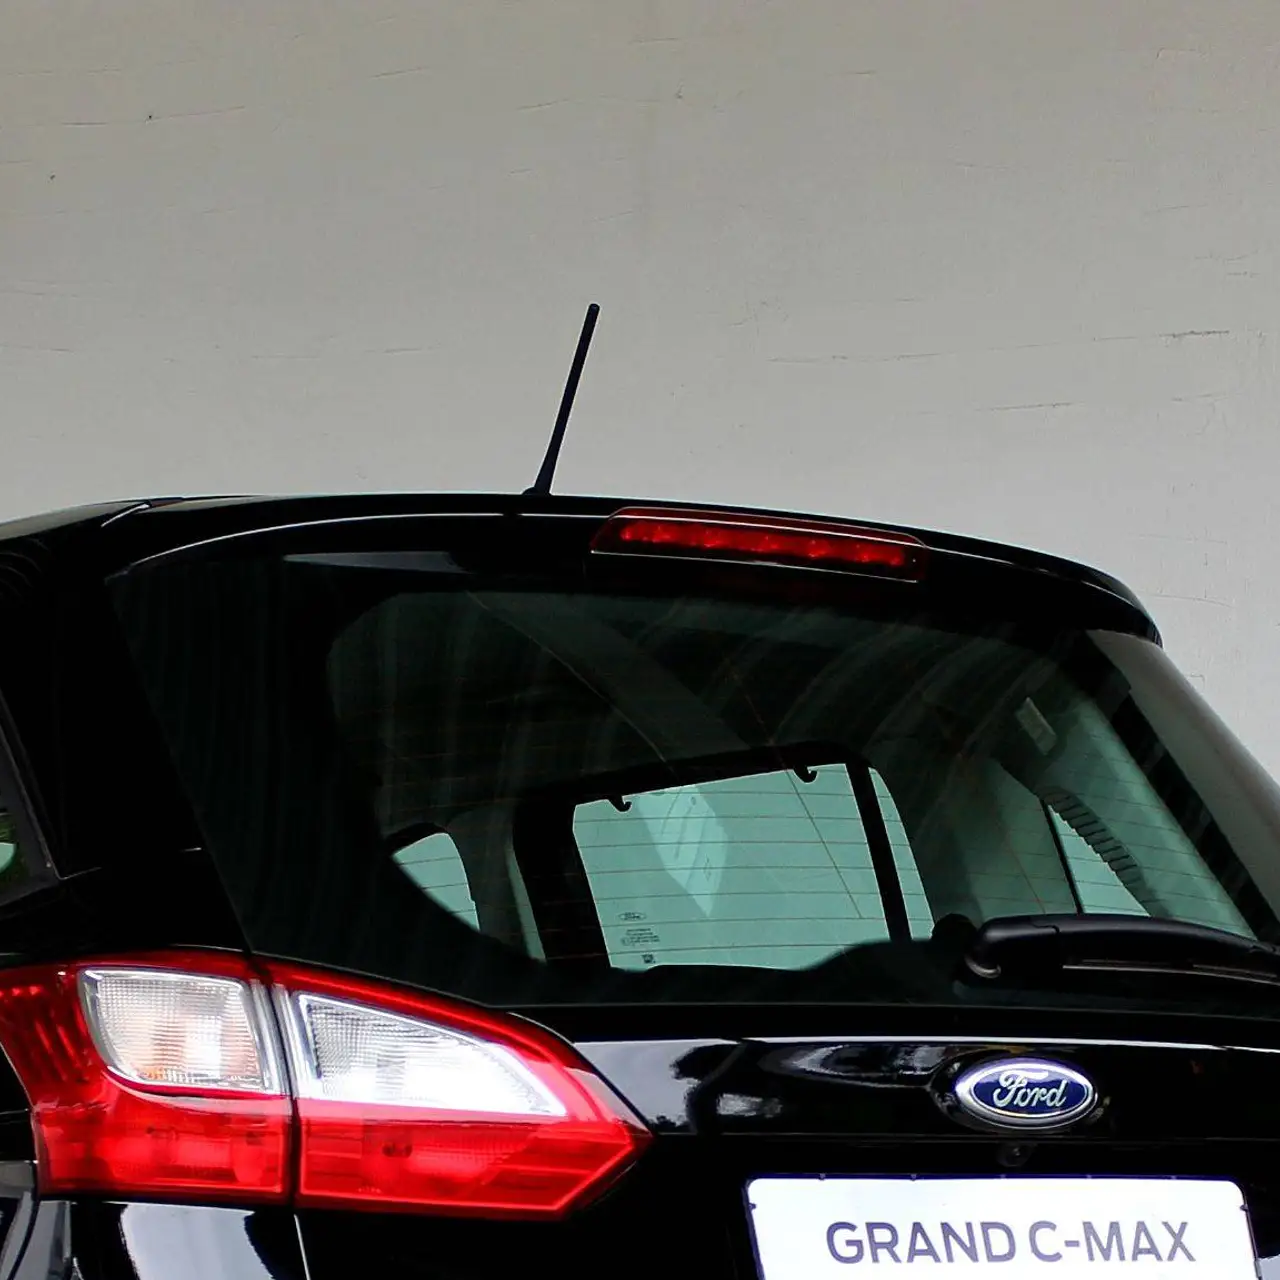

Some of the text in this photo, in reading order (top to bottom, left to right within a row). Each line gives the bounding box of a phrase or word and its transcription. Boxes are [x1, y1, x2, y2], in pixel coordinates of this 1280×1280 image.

[992, 1069, 1068, 1108] Ford
[824, 1220, 1197, 1265] GRAND C-MAX
